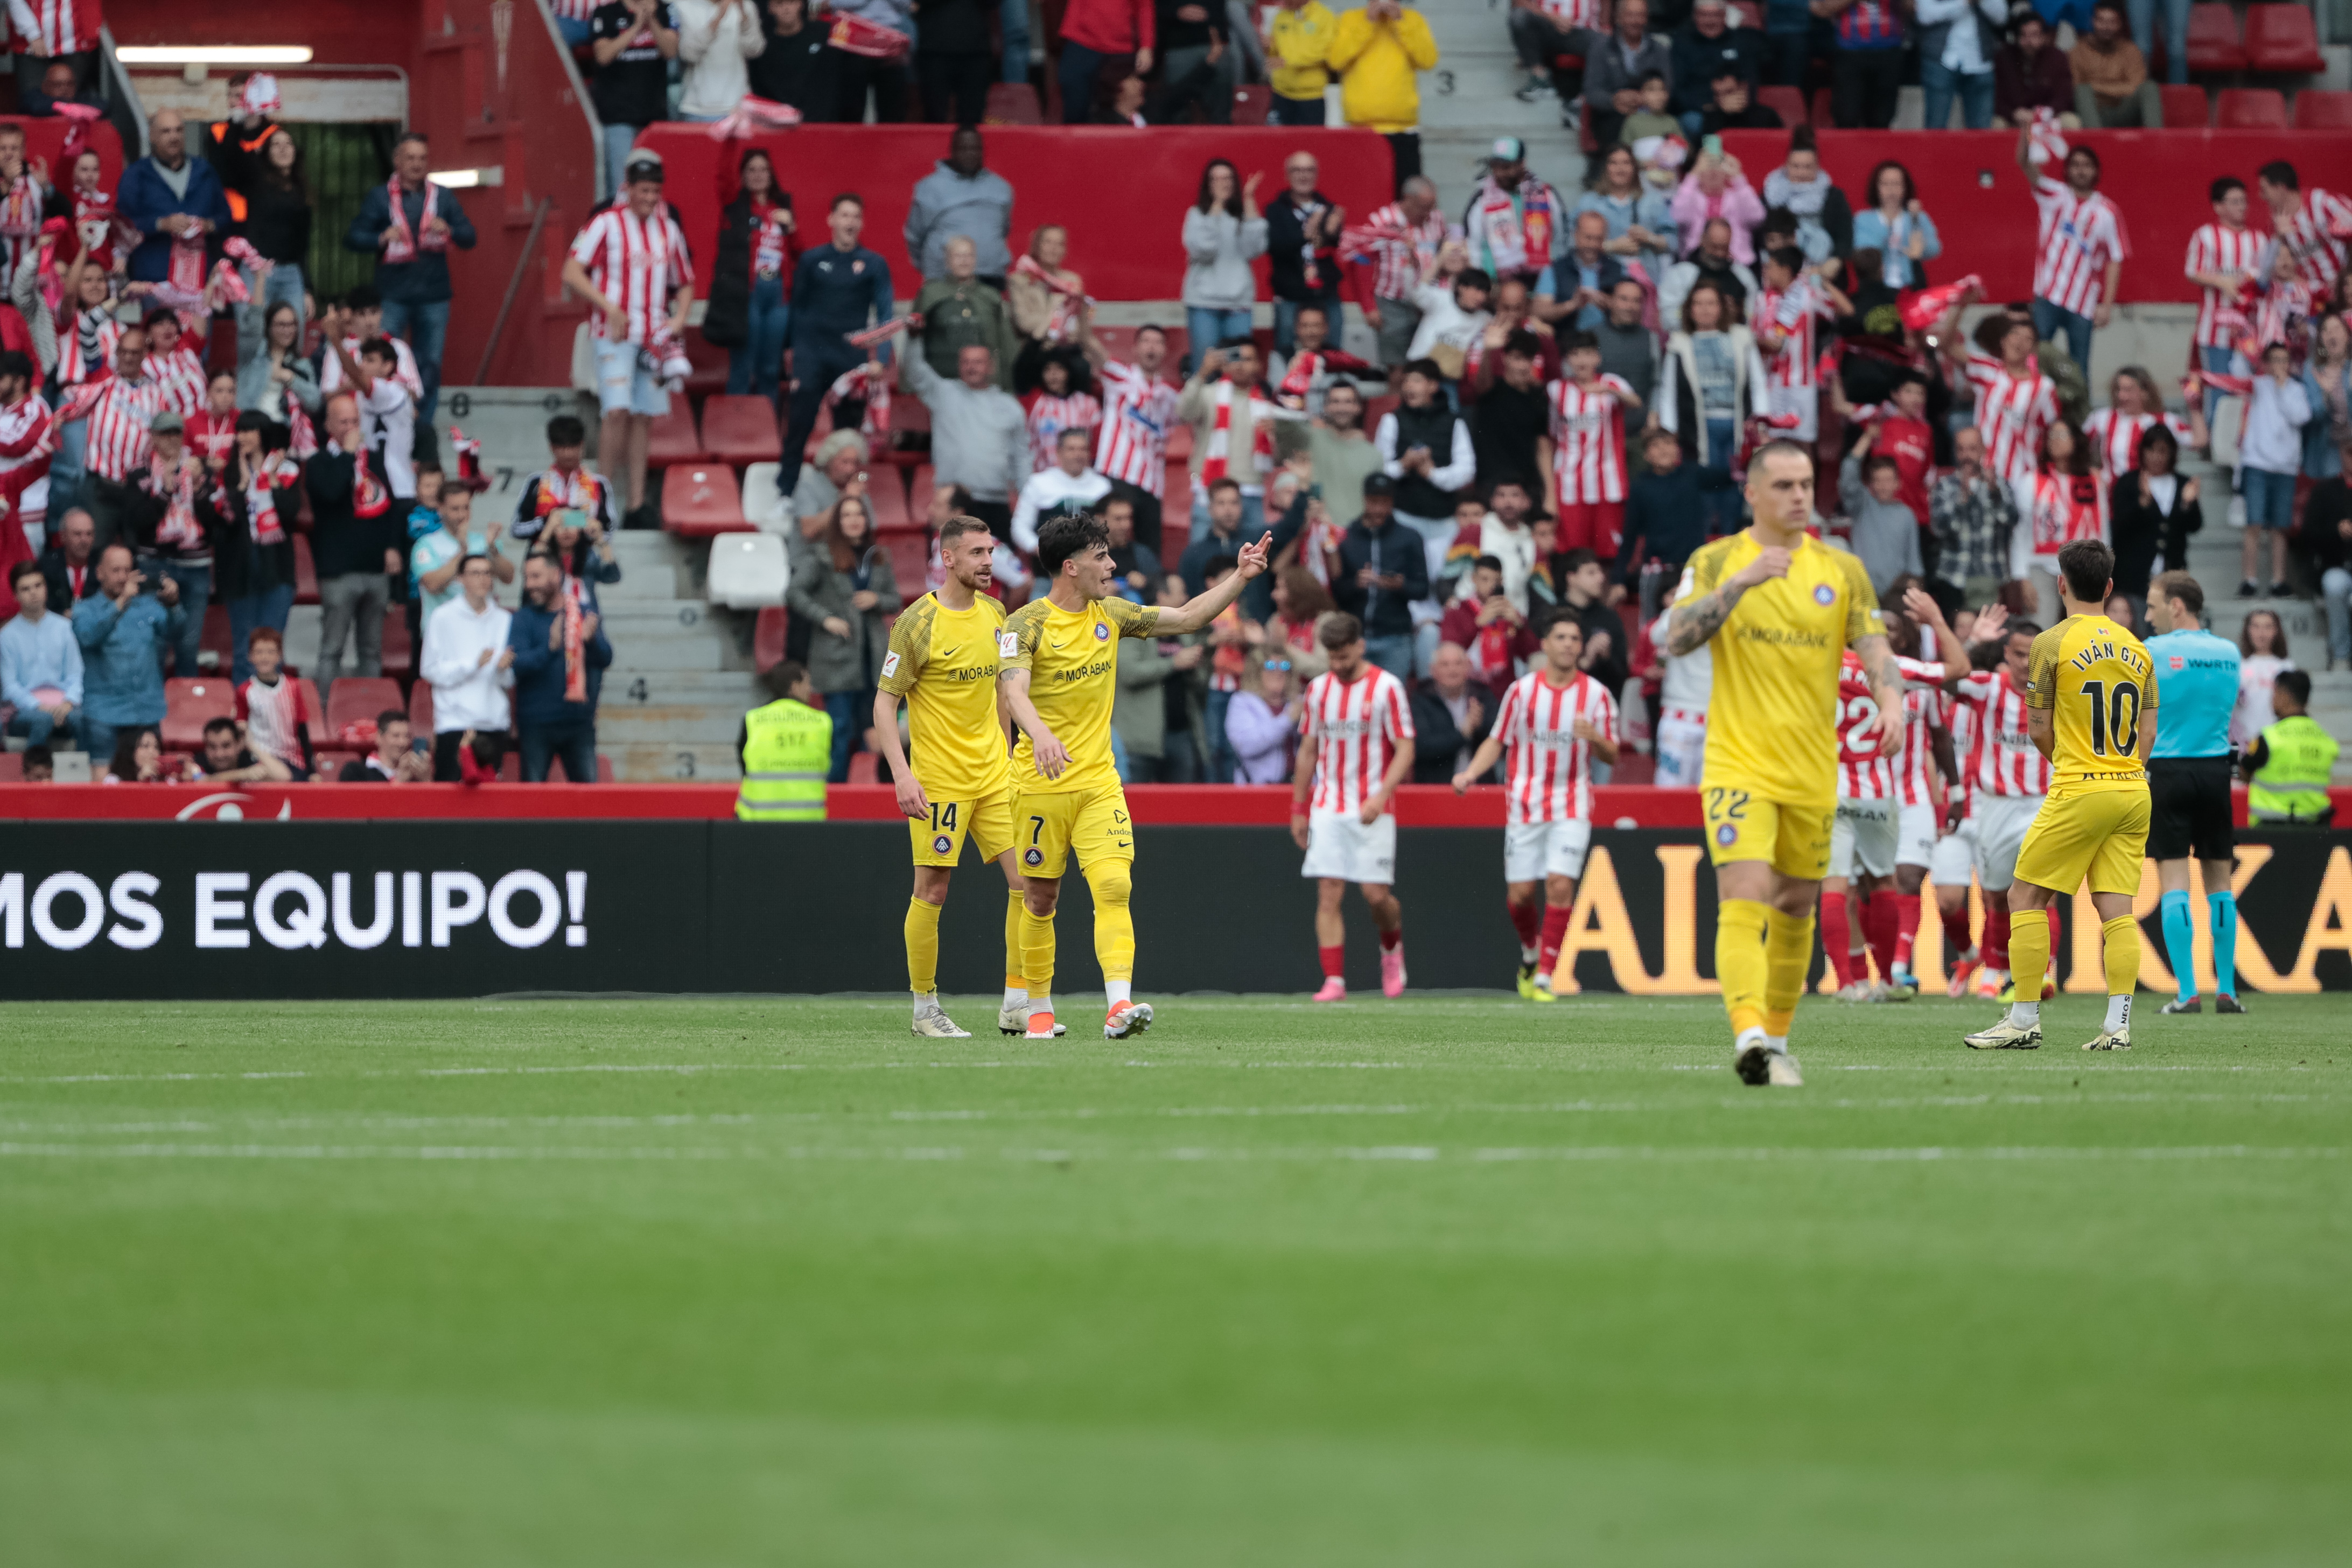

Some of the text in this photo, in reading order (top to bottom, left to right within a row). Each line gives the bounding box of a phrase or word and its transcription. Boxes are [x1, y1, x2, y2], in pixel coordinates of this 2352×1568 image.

[1437, 69, 1455, 96] 3
[450, 393, 470, 418] 8
[496, 467, 514, 492] 7
[2071, 639, 2144, 674] IVÁN GIL
[628, 676, 648, 702] 4
[2080, 681, 2140, 757] 10
[929, 802, 957, 832] 14
[1709, 787, 1748, 820] 22
[1030, 815, 1045, 845] 7
[195, 869, 587, 949] EQUIPO!
